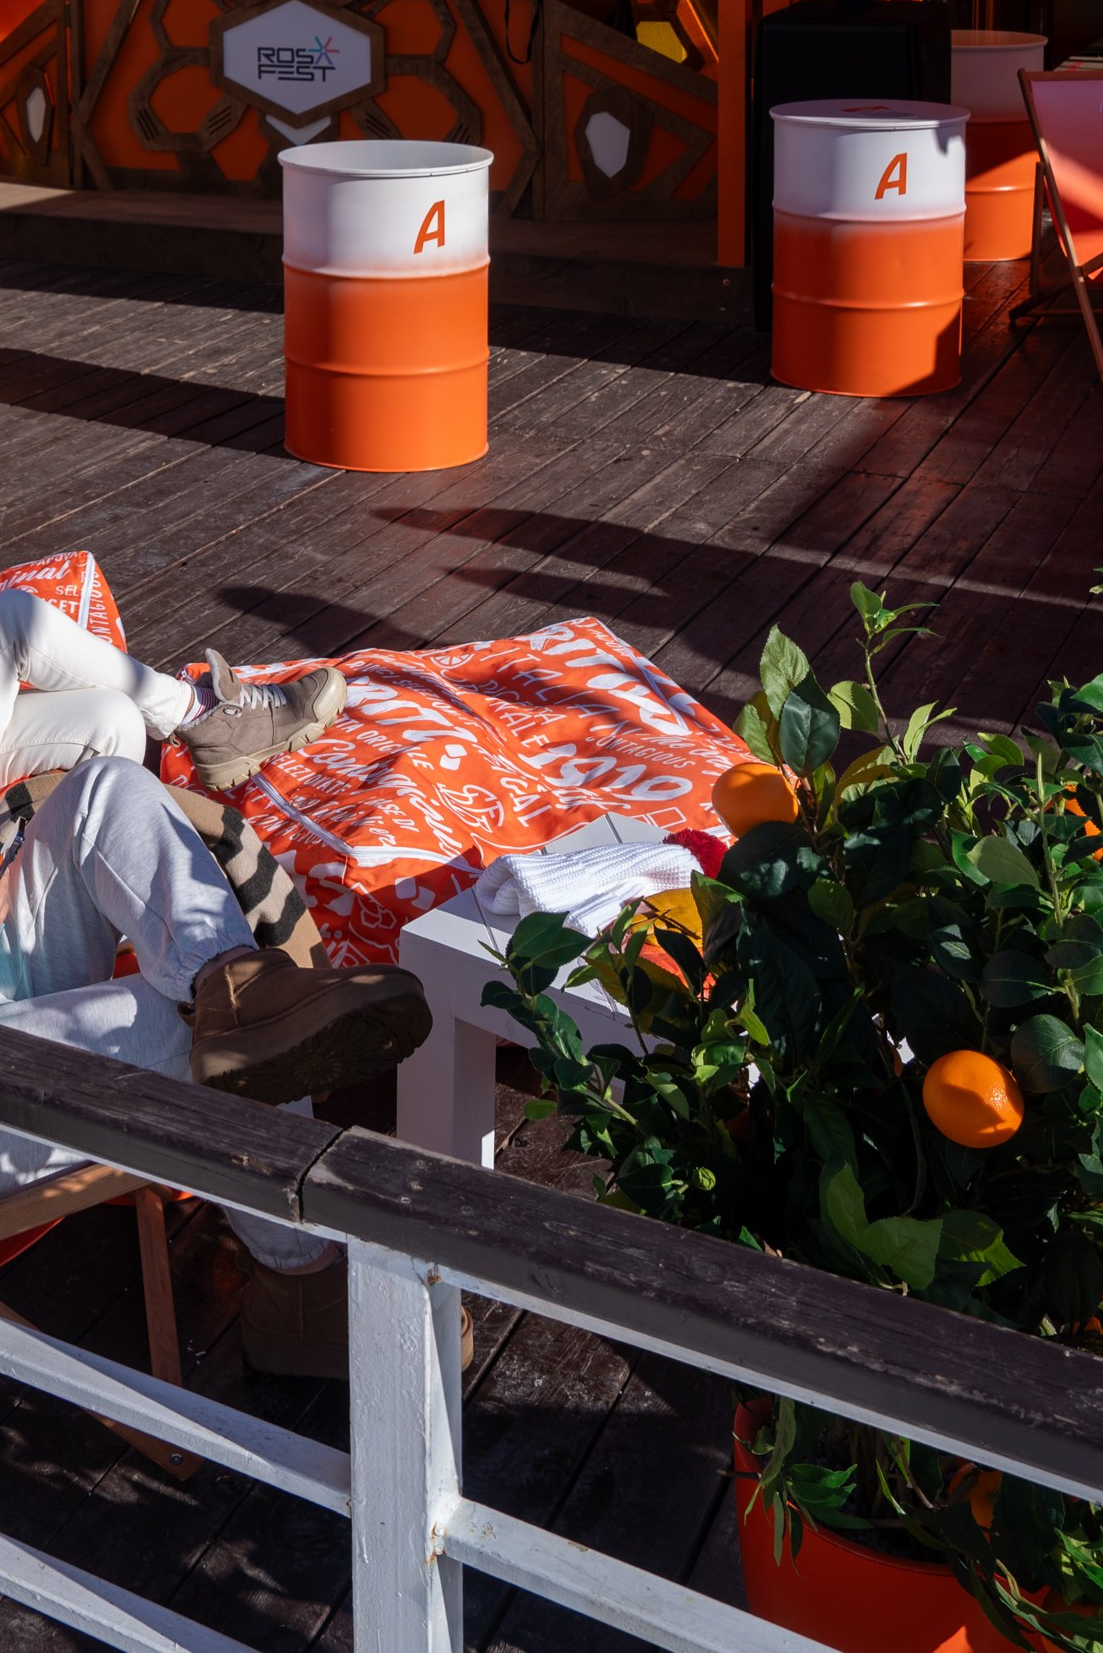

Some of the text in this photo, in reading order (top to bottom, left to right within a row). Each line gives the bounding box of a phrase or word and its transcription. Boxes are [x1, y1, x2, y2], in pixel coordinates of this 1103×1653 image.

[258, 64, 336, 82] FEST
[874, 152, 907, 200] A
[413, 199, 445, 256] A
[95, 570, 114, 644] ONTAGIOUS
